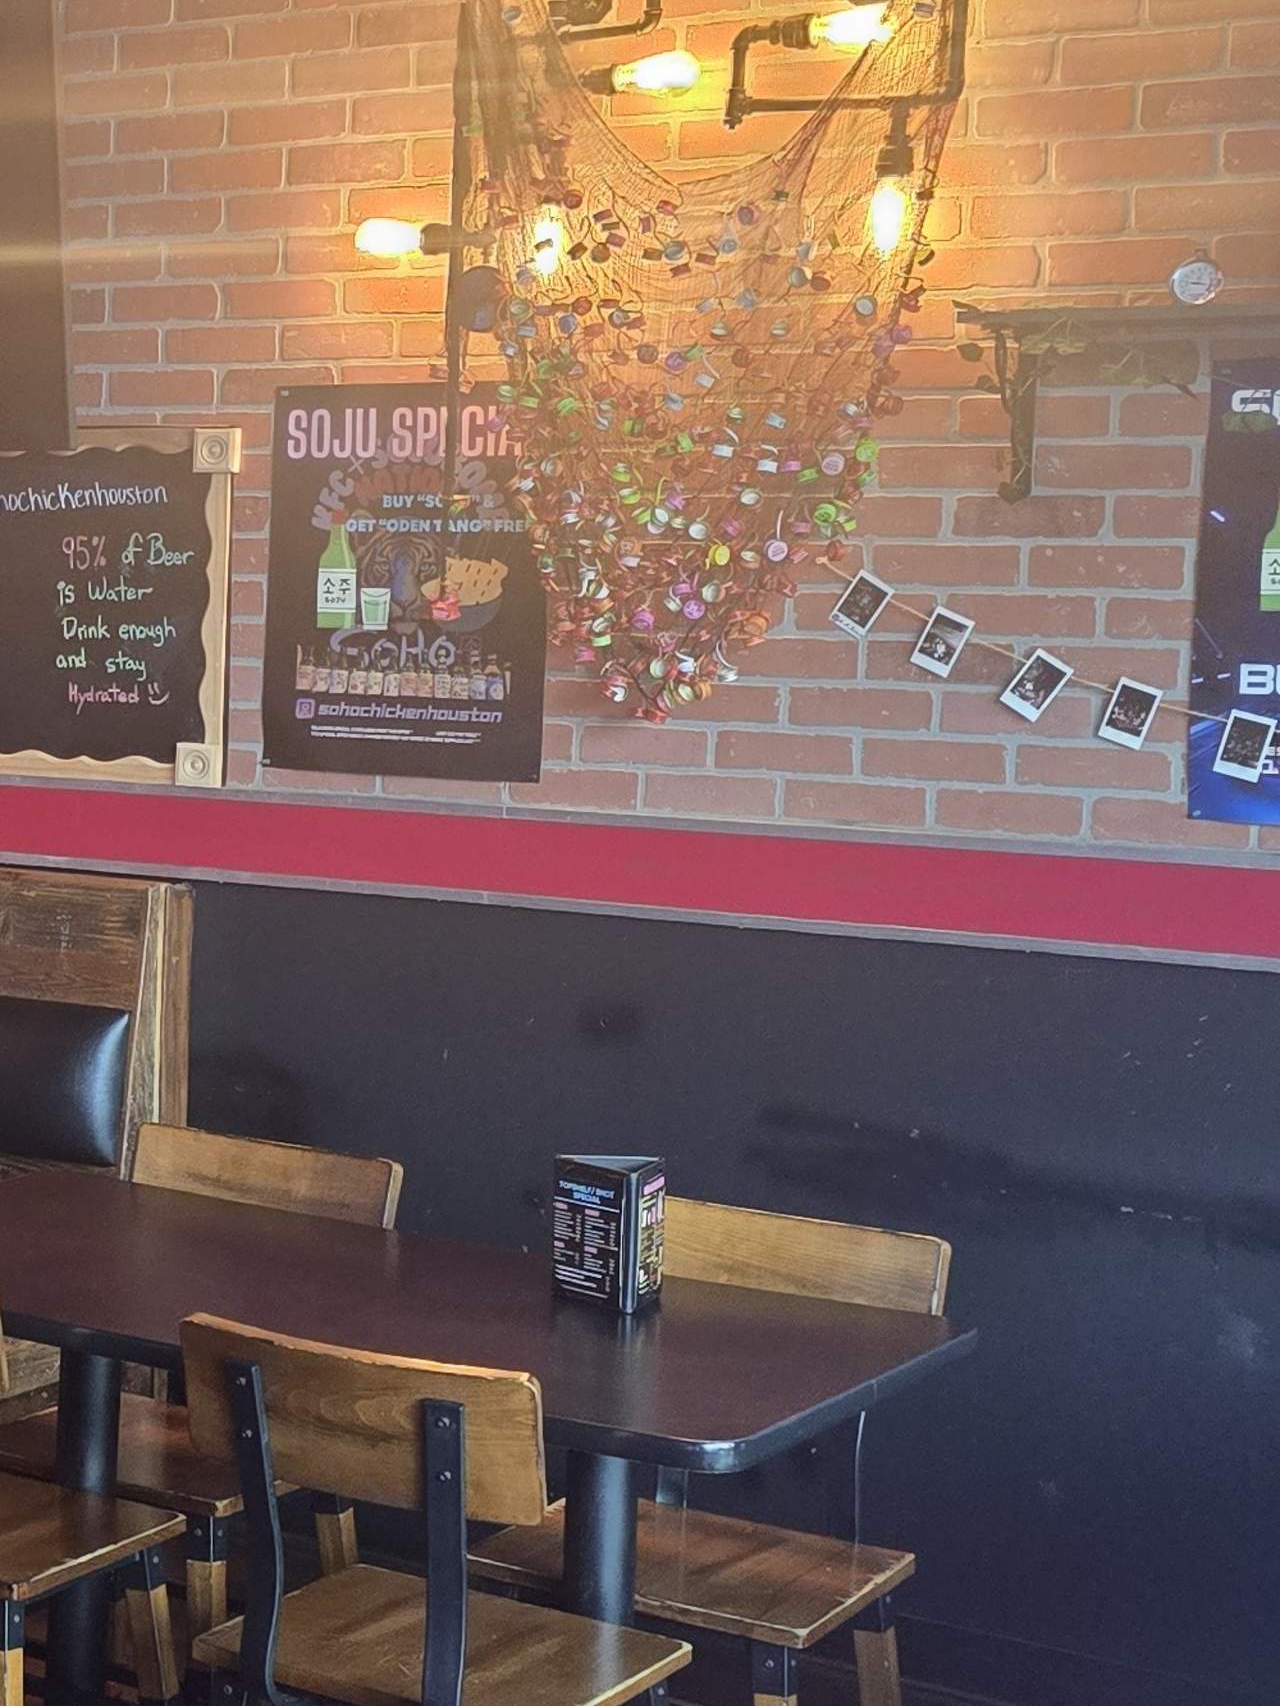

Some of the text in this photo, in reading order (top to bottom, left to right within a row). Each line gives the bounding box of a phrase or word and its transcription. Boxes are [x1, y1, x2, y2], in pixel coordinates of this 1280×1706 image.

[287, 407, 377, 459] SOJU
[382, 494, 414, 508] BUY
[345, 519, 377, 533] GET
[62, 532, 194, 570] 95% of Beer
[56, 575, 153, 606] is Water
[322, 577, 351, 595] 소주
[61, 614, 177, 648] Drink enough
[55, 647, 147, 681] and stay
[68, 682, 140, 715] Hydrated
[318, 701, 503, 723] sohochickenhouston
